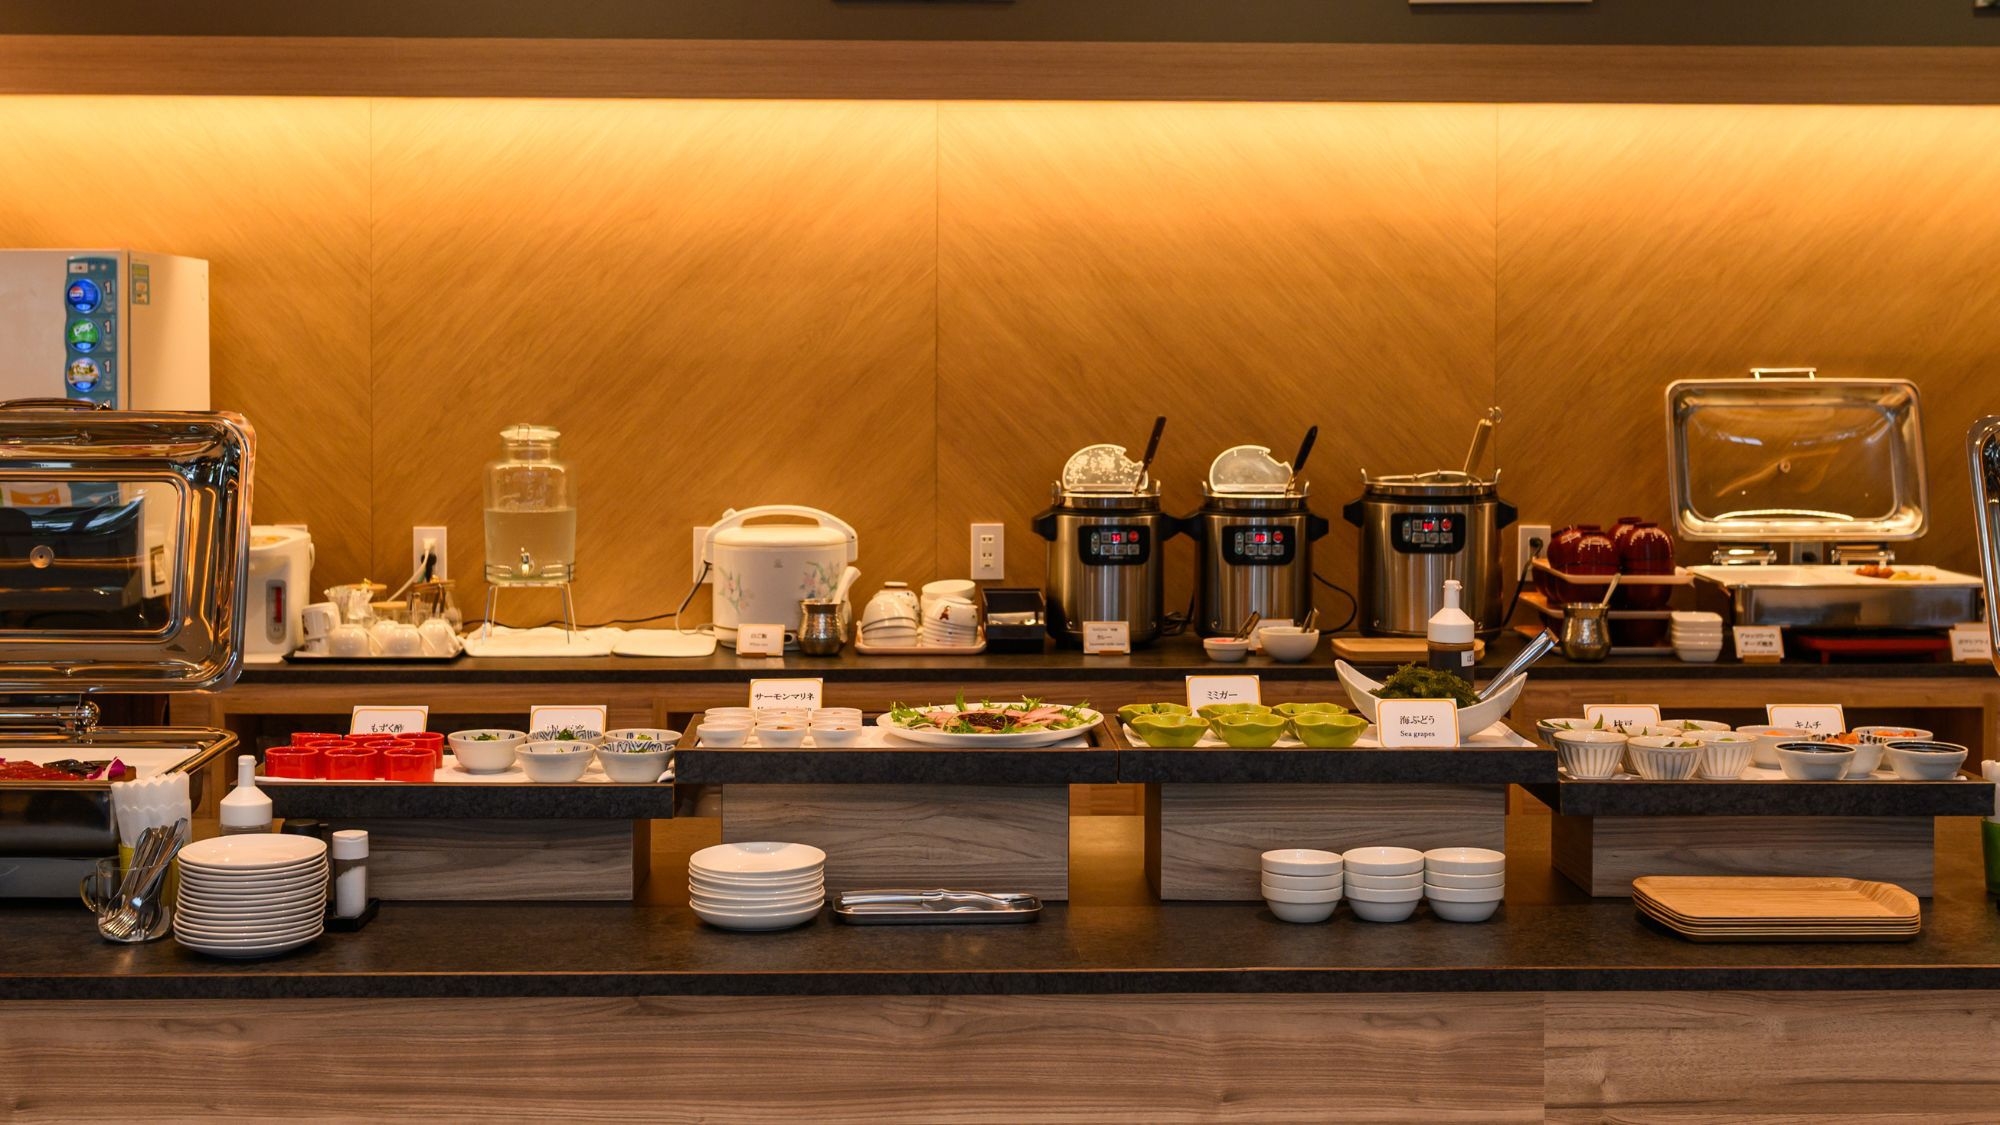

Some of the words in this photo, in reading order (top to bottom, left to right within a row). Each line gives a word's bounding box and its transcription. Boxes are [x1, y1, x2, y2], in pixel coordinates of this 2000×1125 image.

[755, 692, 815, 701] サーモンマリネ
[1207, 690, 1239, 700] ミミガー
[1399, 715, 1435, 725] 海ぶどう
[1794, 720, 1822, 729] キムチ
[1413, 731, 1436, 739] grapes
